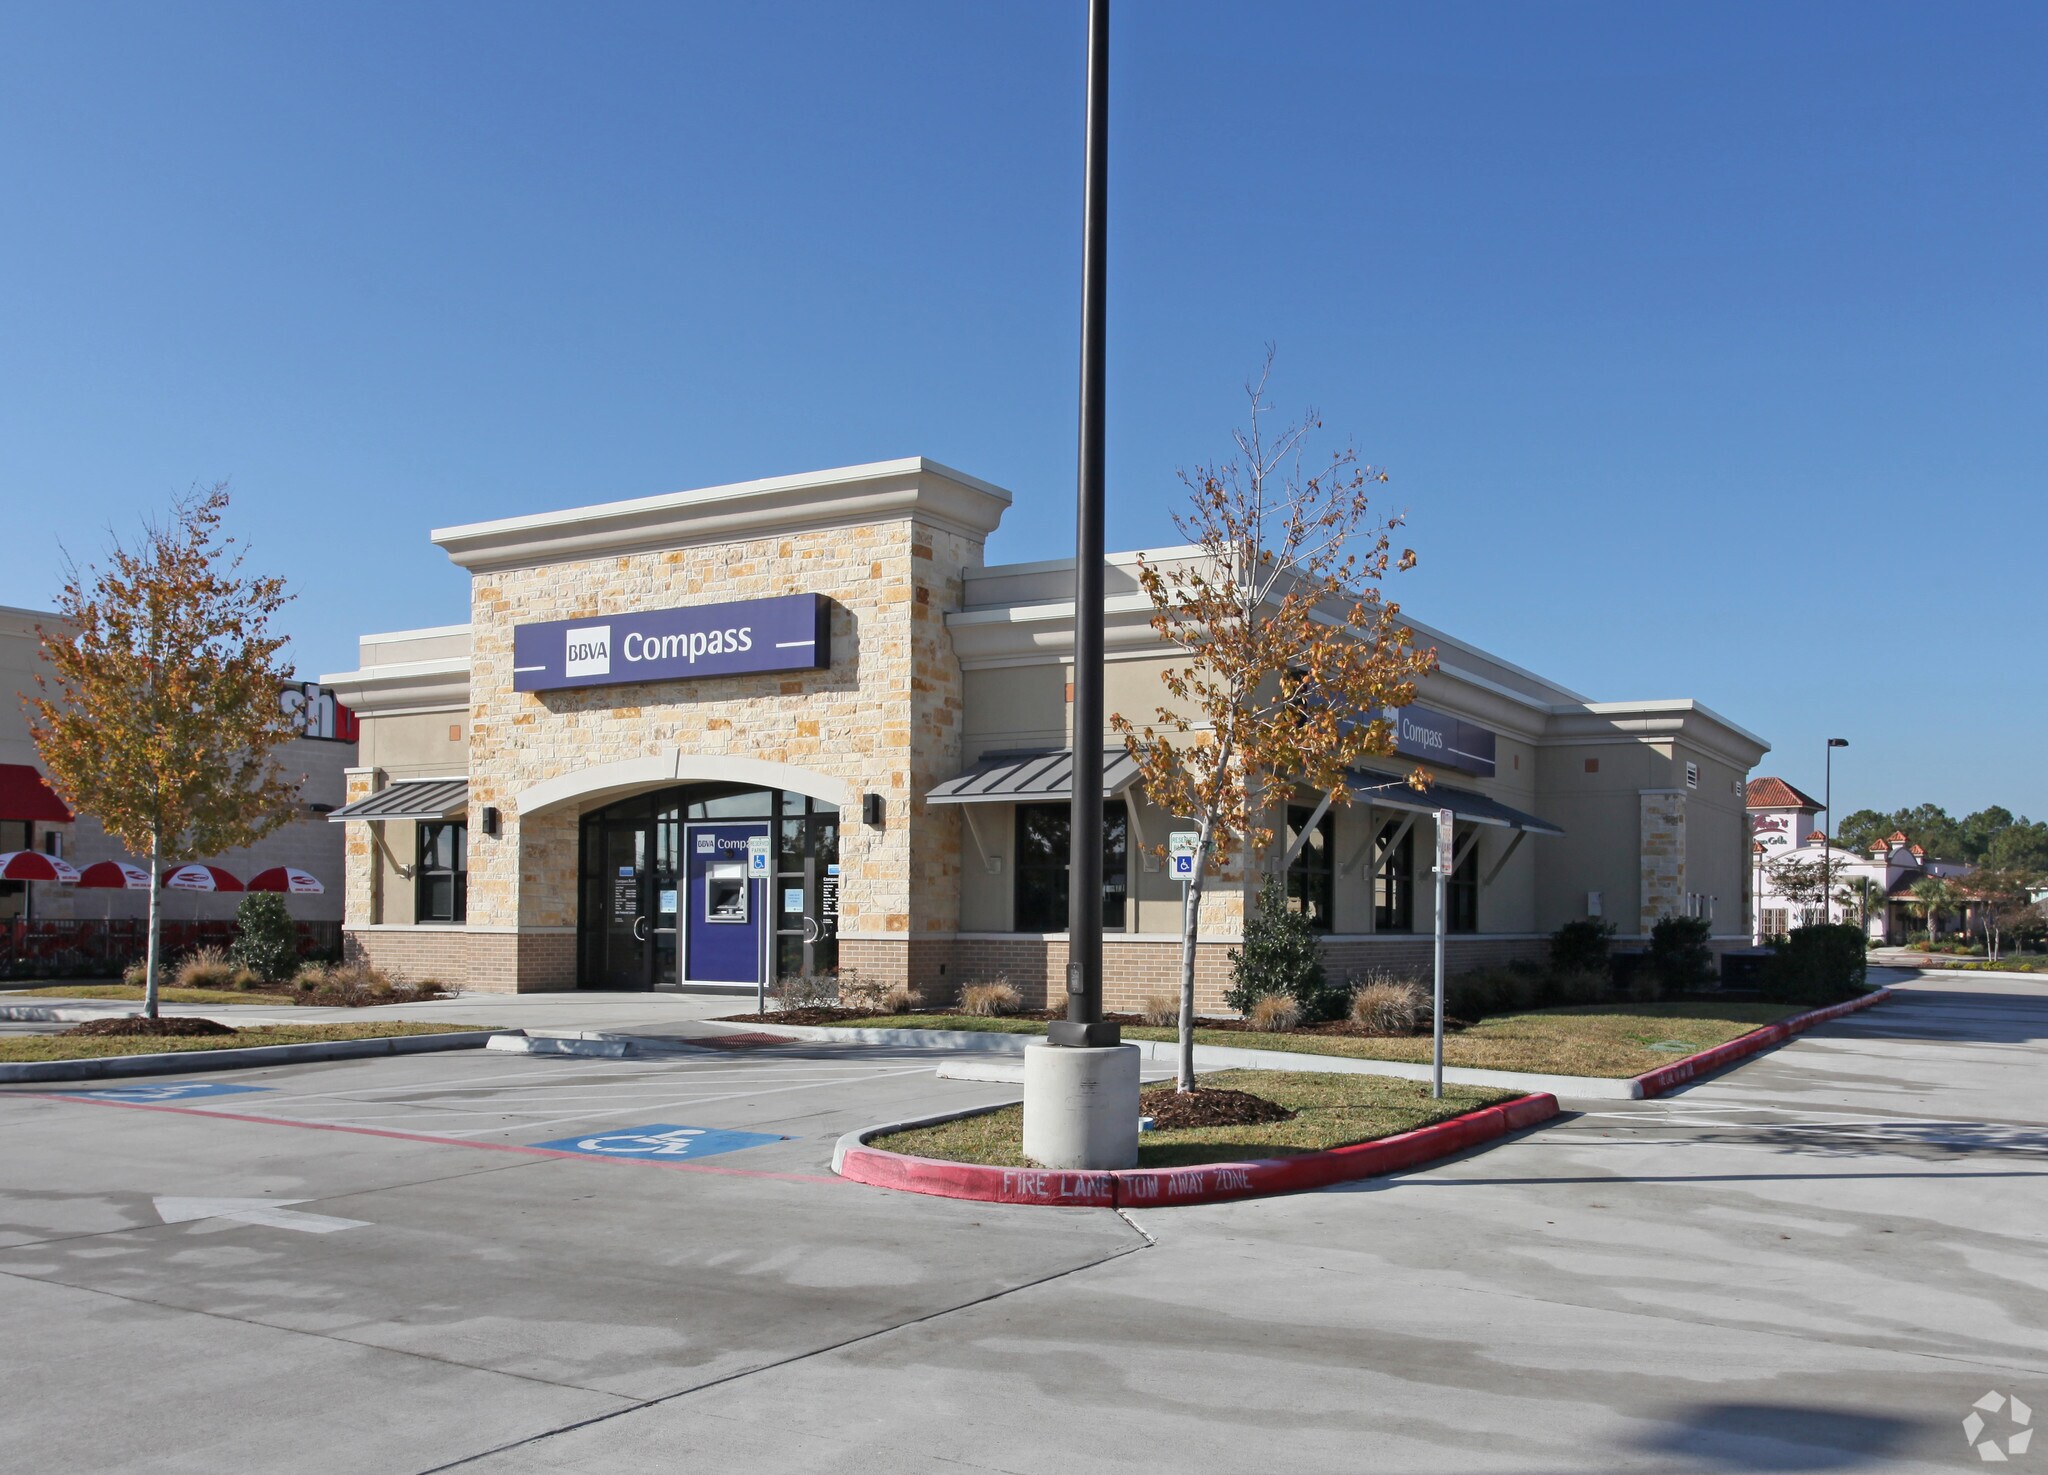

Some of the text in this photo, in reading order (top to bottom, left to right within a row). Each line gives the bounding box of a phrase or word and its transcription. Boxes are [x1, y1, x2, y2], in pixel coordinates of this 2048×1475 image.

[568, 626, 752, 663] BBVA Compass
[1402, 717, 1443, 750] Compass
[697, 839, 714, 848] BBVA
[1003, 1167, 1253, 1198] FIRE LANE TOW AWAY ZONE
